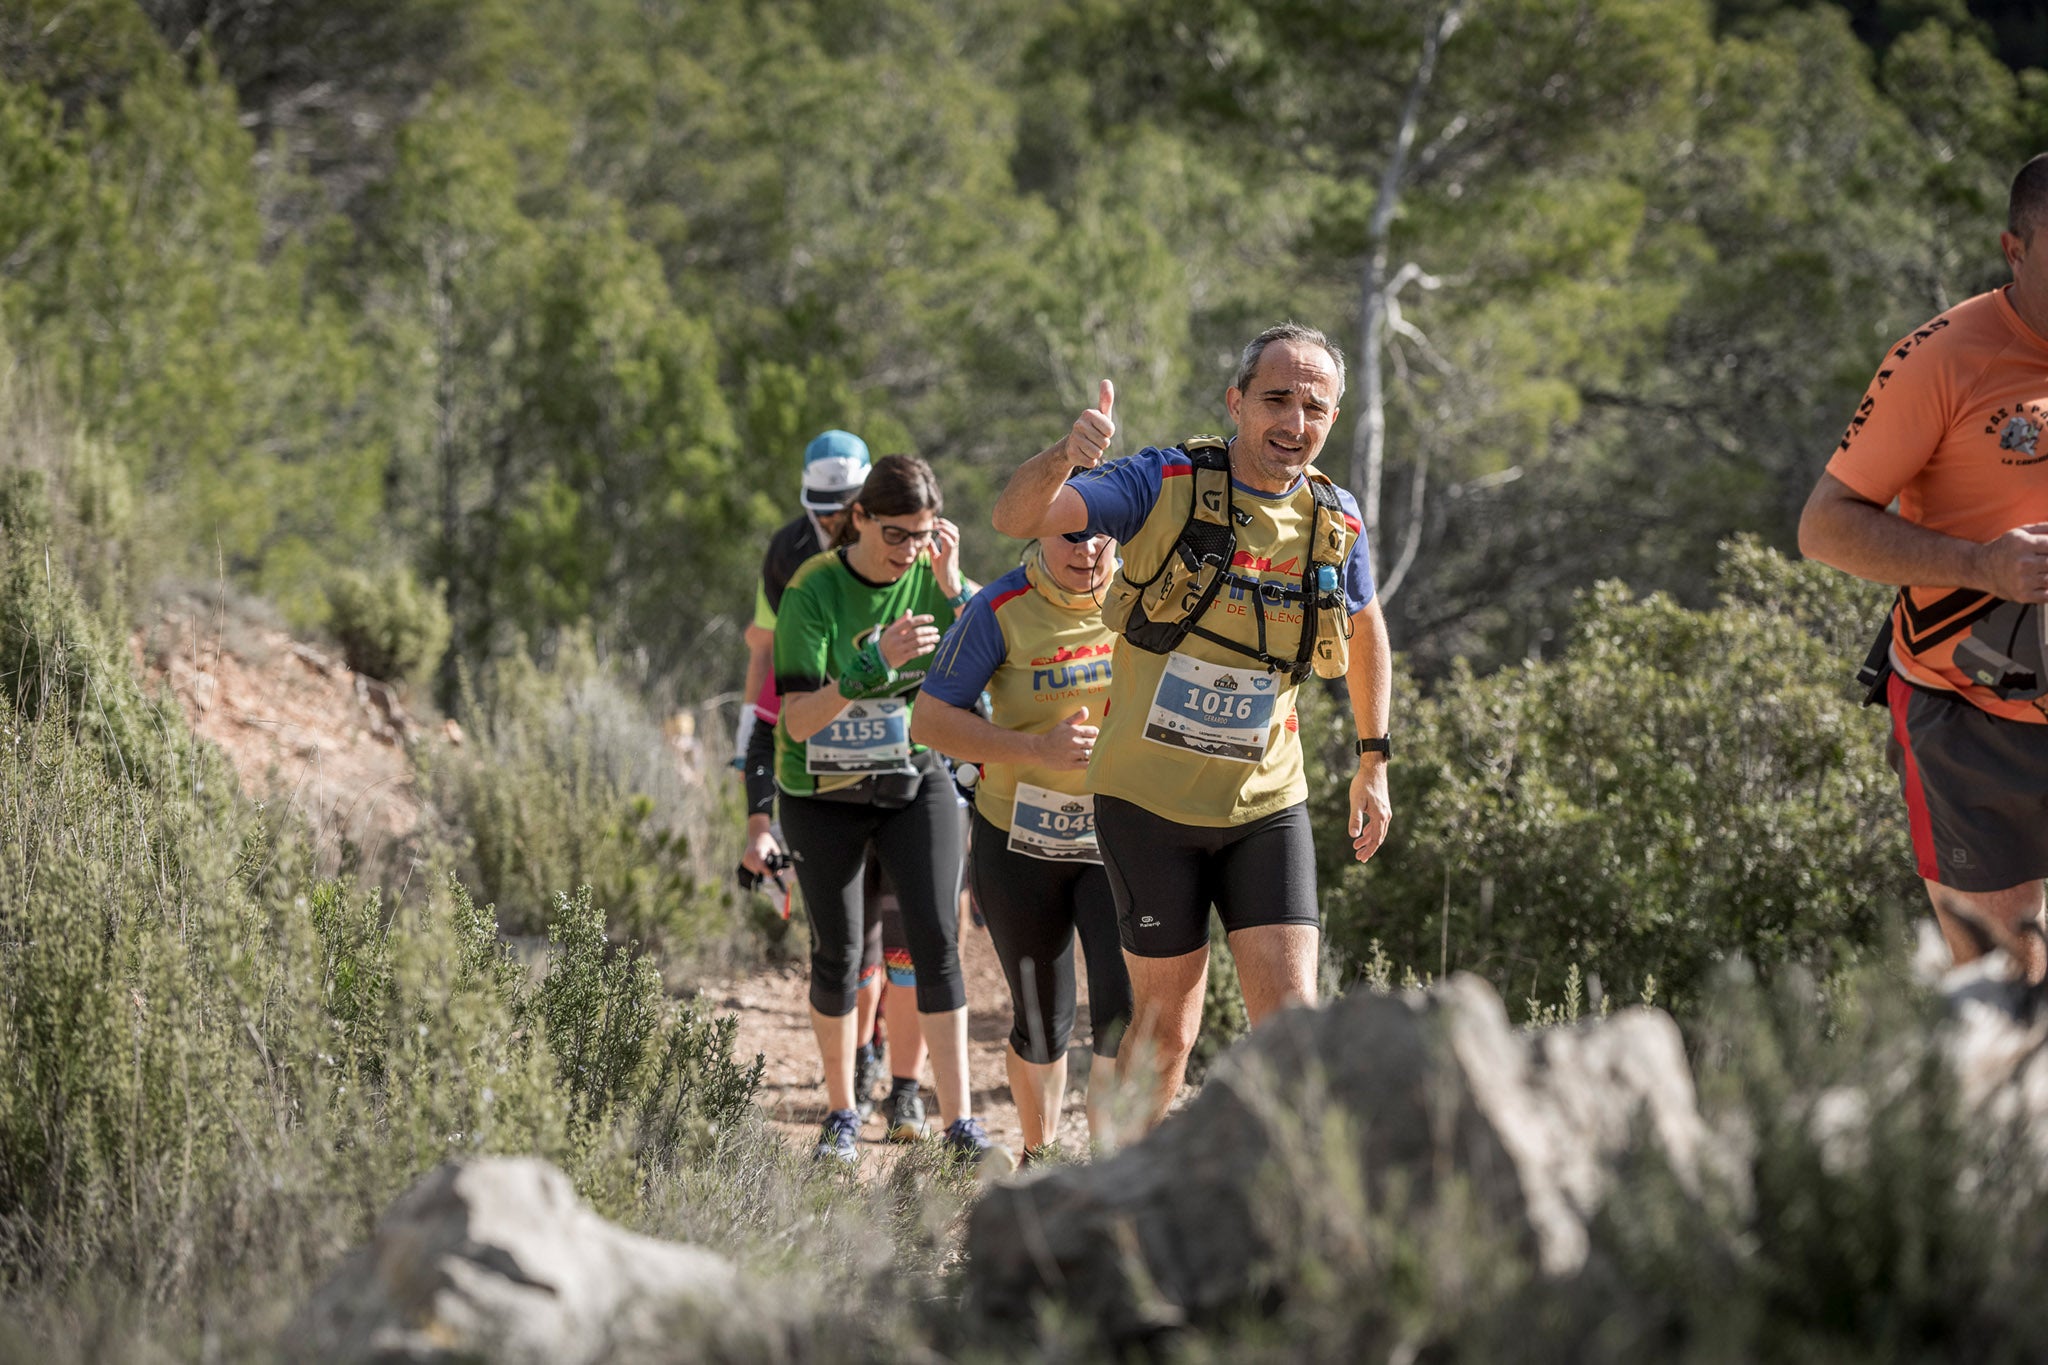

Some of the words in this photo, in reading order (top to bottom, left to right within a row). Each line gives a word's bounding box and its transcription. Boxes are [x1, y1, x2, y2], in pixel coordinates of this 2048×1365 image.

[1839, 395, 1875, 452] PAS
[1877, 369, 1895, 390] A
[1894, 317, 1949, 360] PAS
[1985, 408, 2008, 434] PAS
[2015, 403, 2024, 413] A
[2031, 405, 2048, 425] PA
[1226, 603, 1247, 615] DE
[1033, 659, 1112, 691] runn
[1034, 689, 1081, 703] CIUTAT
[1183, 687, 1253, 720] 1016
[830, 721, 886, 741] 1155
